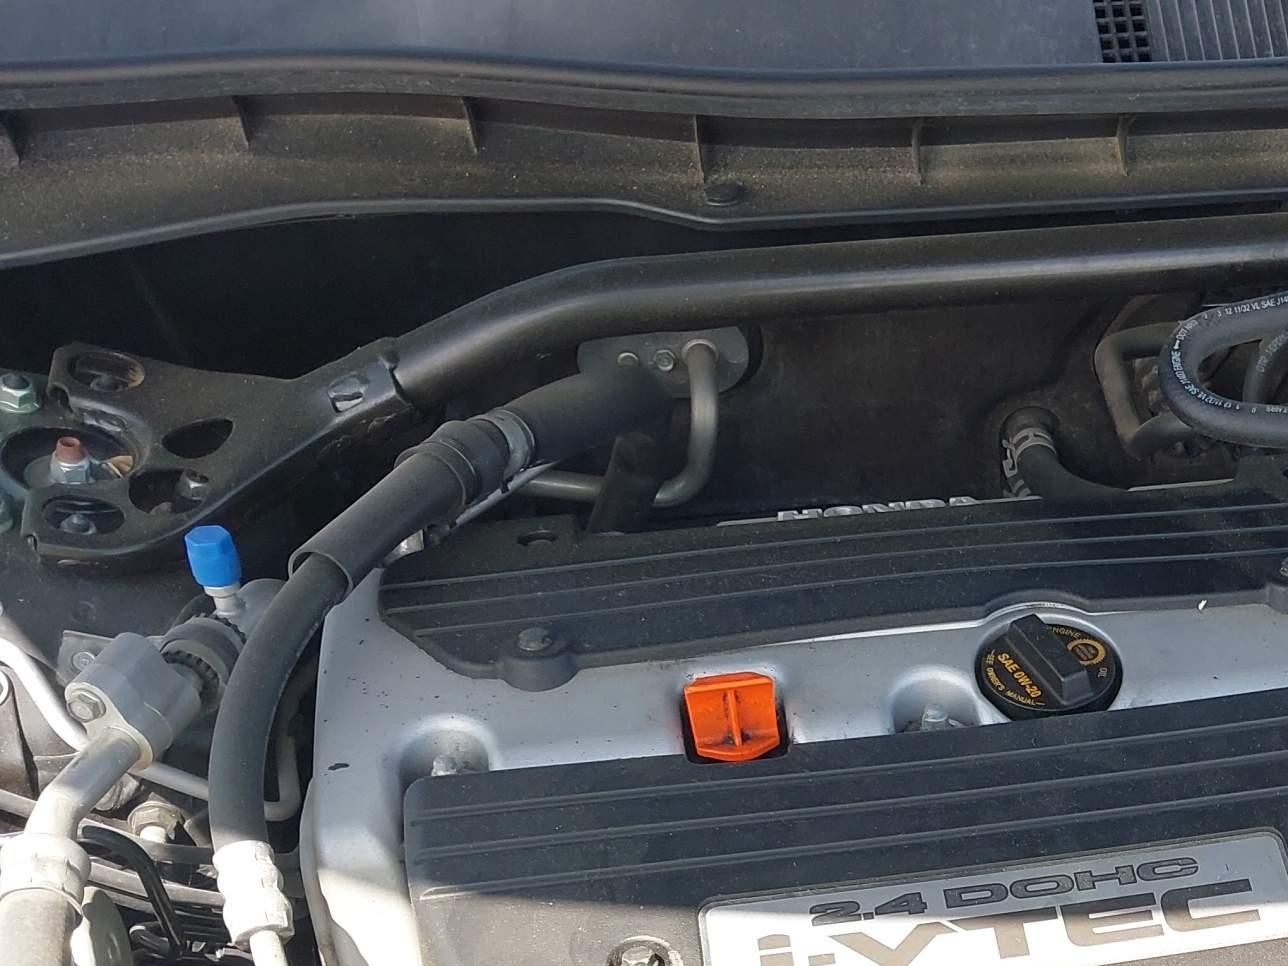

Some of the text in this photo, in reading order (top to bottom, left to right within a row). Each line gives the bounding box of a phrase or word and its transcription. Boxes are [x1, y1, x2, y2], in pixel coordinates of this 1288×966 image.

[1261, 299, 1276, 310] SAE
[777, 496, 981, 522] HONDA
[997, 652, 1043, 699] SAE 0W-20
[1006, 690, 1037, 706] MANUAL
[808, 856, 1199, 926] 2.4 DOHC
